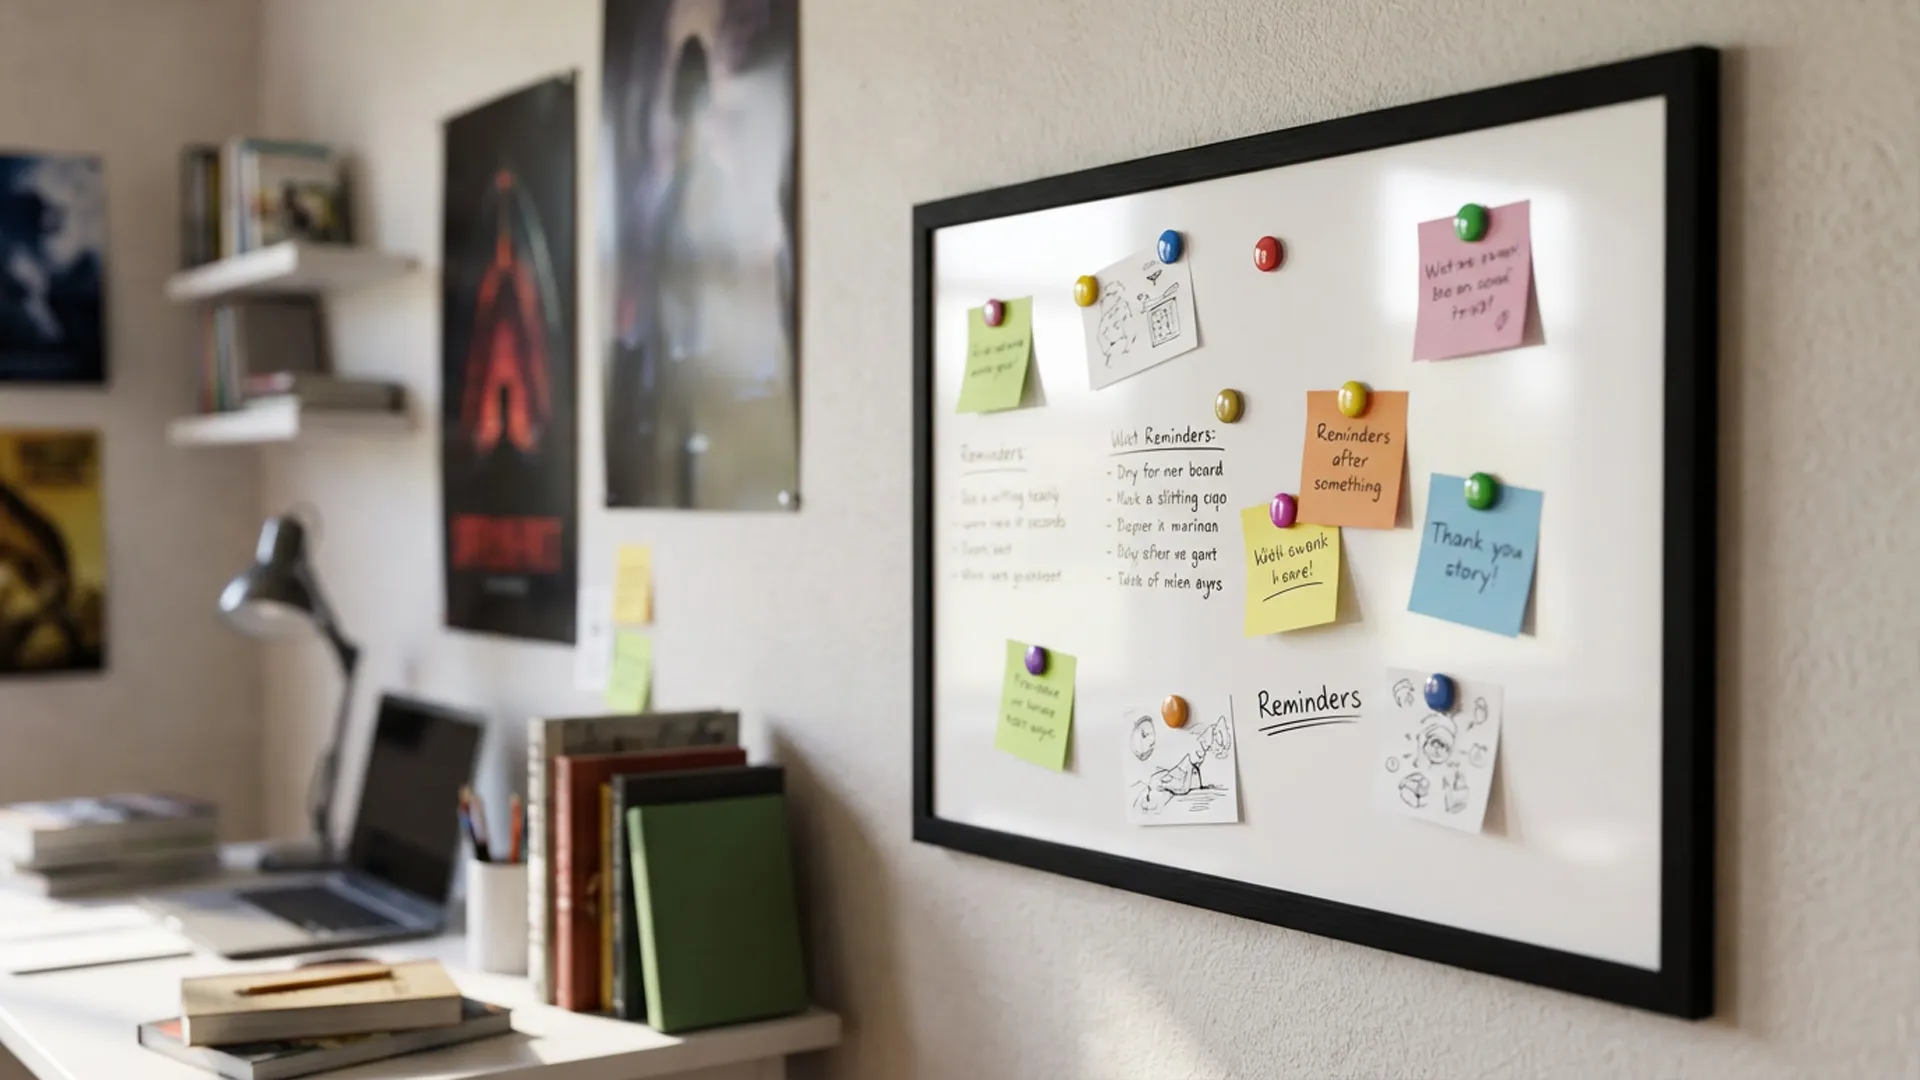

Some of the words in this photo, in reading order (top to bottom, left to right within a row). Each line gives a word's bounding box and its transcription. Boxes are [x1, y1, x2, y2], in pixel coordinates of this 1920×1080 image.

[1145, 425, 1217, 445] Reminders:
[1316, 422, 1392, 445] Reminders
[1332, 448, 1369, 468] after
[1313, 474, 1383, 503] something
[1432, 521, 1484, 552] Thank
[1490, 542, 1523, 564] you
[1257, 684, 1363, 719] Reminders
